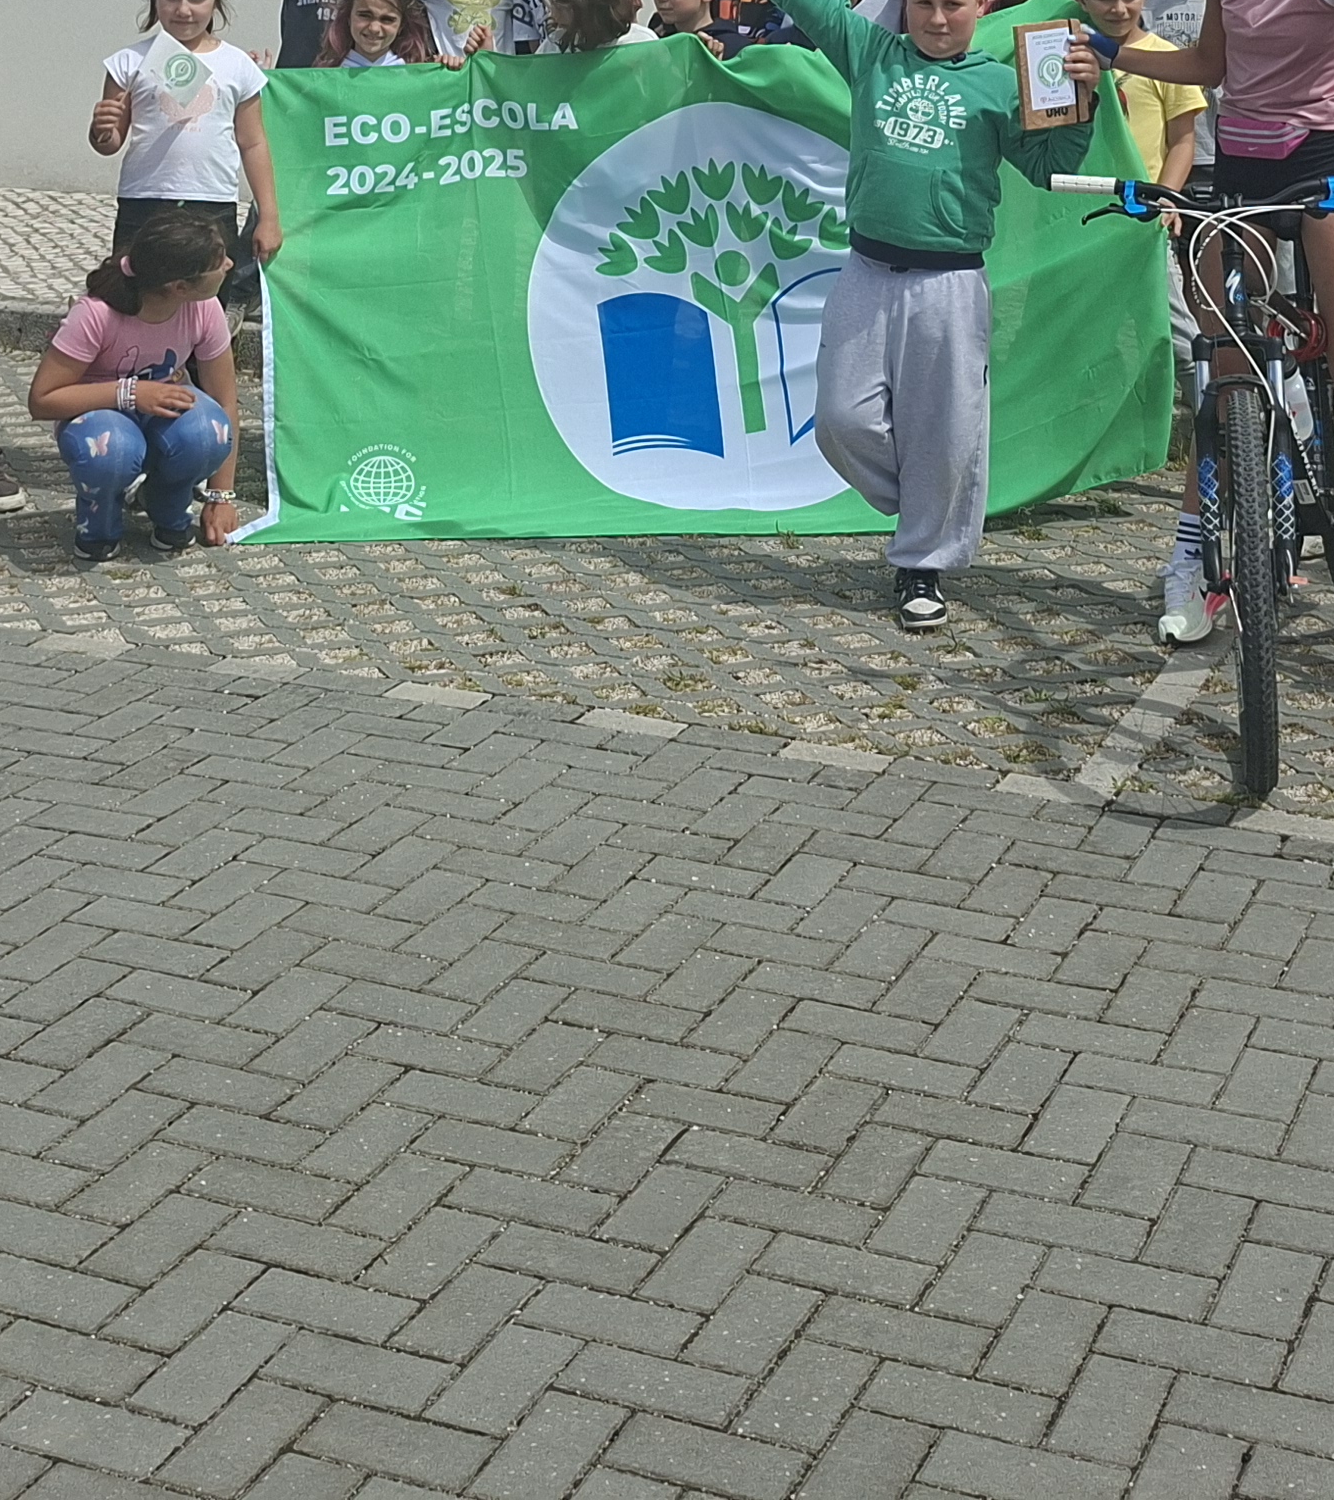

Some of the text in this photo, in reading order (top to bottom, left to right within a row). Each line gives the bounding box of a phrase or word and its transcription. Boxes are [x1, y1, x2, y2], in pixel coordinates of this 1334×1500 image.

[324, 98, 579, 147] ECO-ESCOLA
[875, 74, 967, 130] TIMBERLAND
[890, 118, 938, 146] 1973
[326, 148, 528, 195] 2024-2025
[347, 443, 417, 466] FOUNDATION FOR
